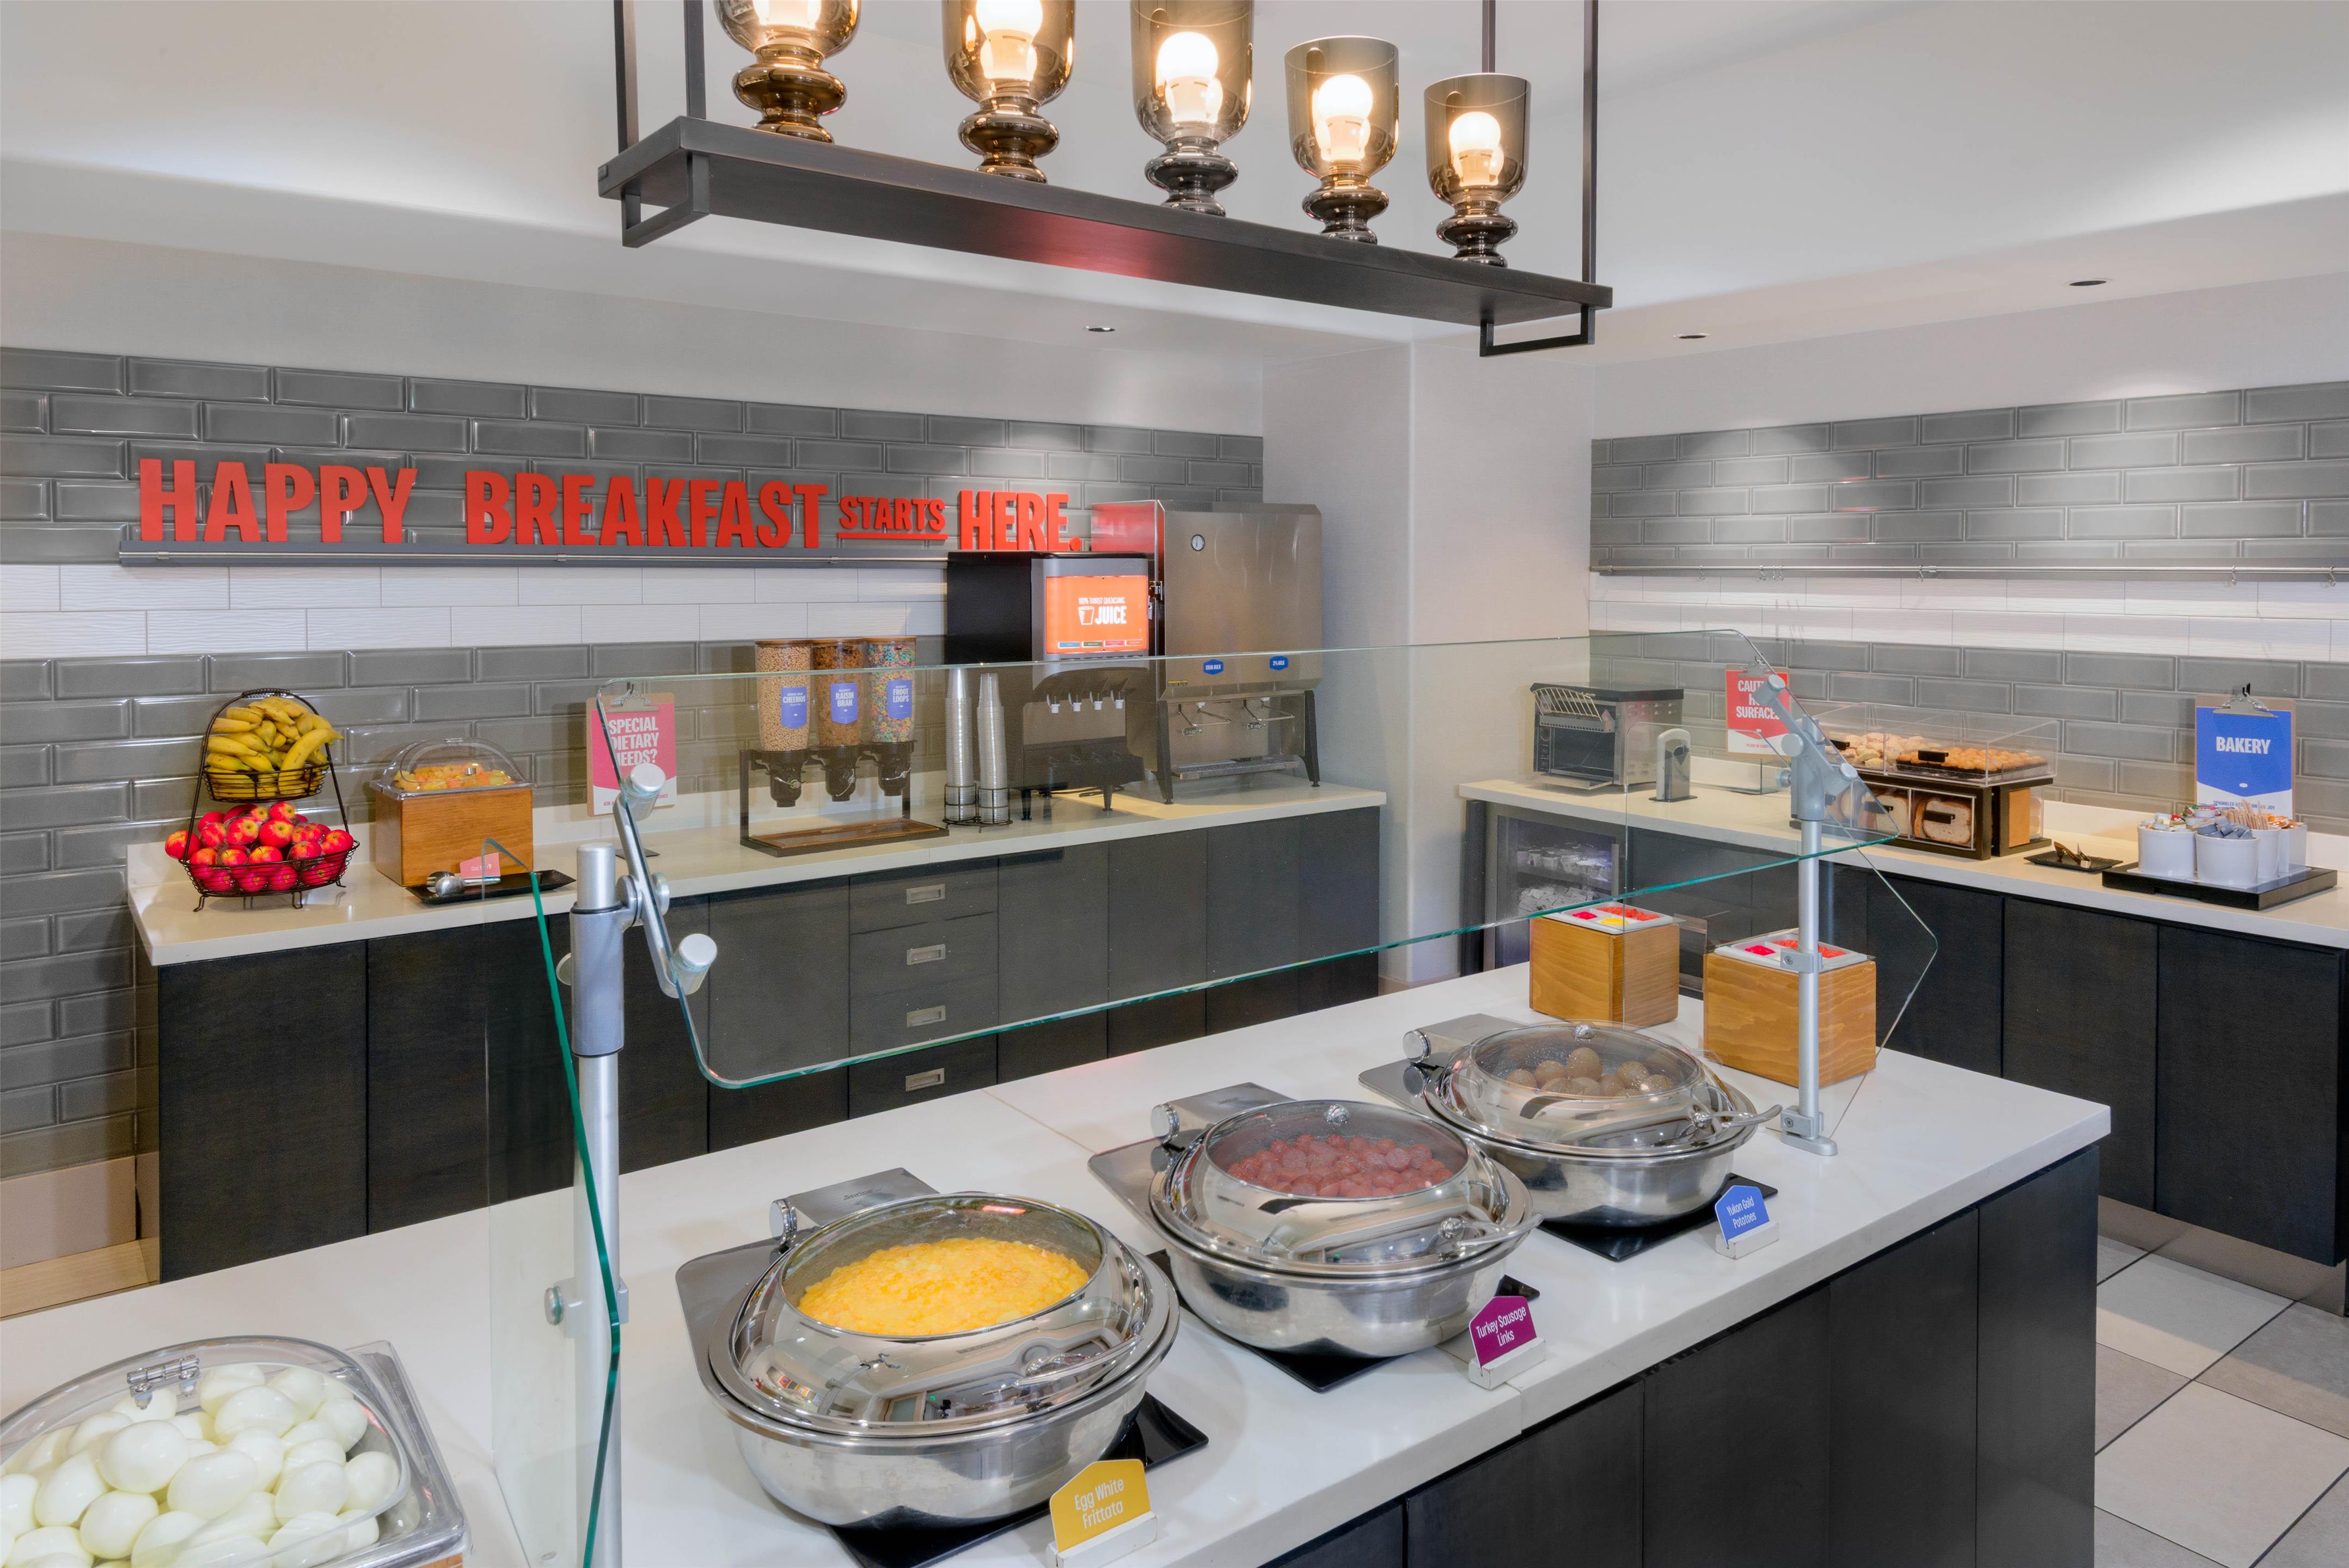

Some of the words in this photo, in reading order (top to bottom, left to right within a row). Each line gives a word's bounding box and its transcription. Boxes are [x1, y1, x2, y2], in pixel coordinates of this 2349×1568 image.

[139, 458, 418, 543] HAPPY
[466, 470, 828, 548] BREAKFAST
[839, 496, 946, 531] STARTS
[959, 490, 1081, 551] HERE.
[1095, 605, 1127, 624] JUICE
[1738, 680, 1764, 692] CAUT
[1736, 706, 1779, 720] SURFACE
[609, 716, 658, 734] SPECIAL
[2216, 736, 2271, 754] BAKERY
[1726, 1203, 1743, 1216] Yukon
[1742, 1196, 1754, 1210] Gold
[1733, 1212, 1757, 1229] Potatoes
[1476, 1320, 1498, 1338] Turkey
[1498, 1307, 1526, 1328] Sausage
[1497, 1330, 1515, 1346] Links
[1074, 1492, 1094, 1511] Egg
[1095, 1478, 1124, 1501] White
[1082, 1500, 1124, 1529] Frittata
